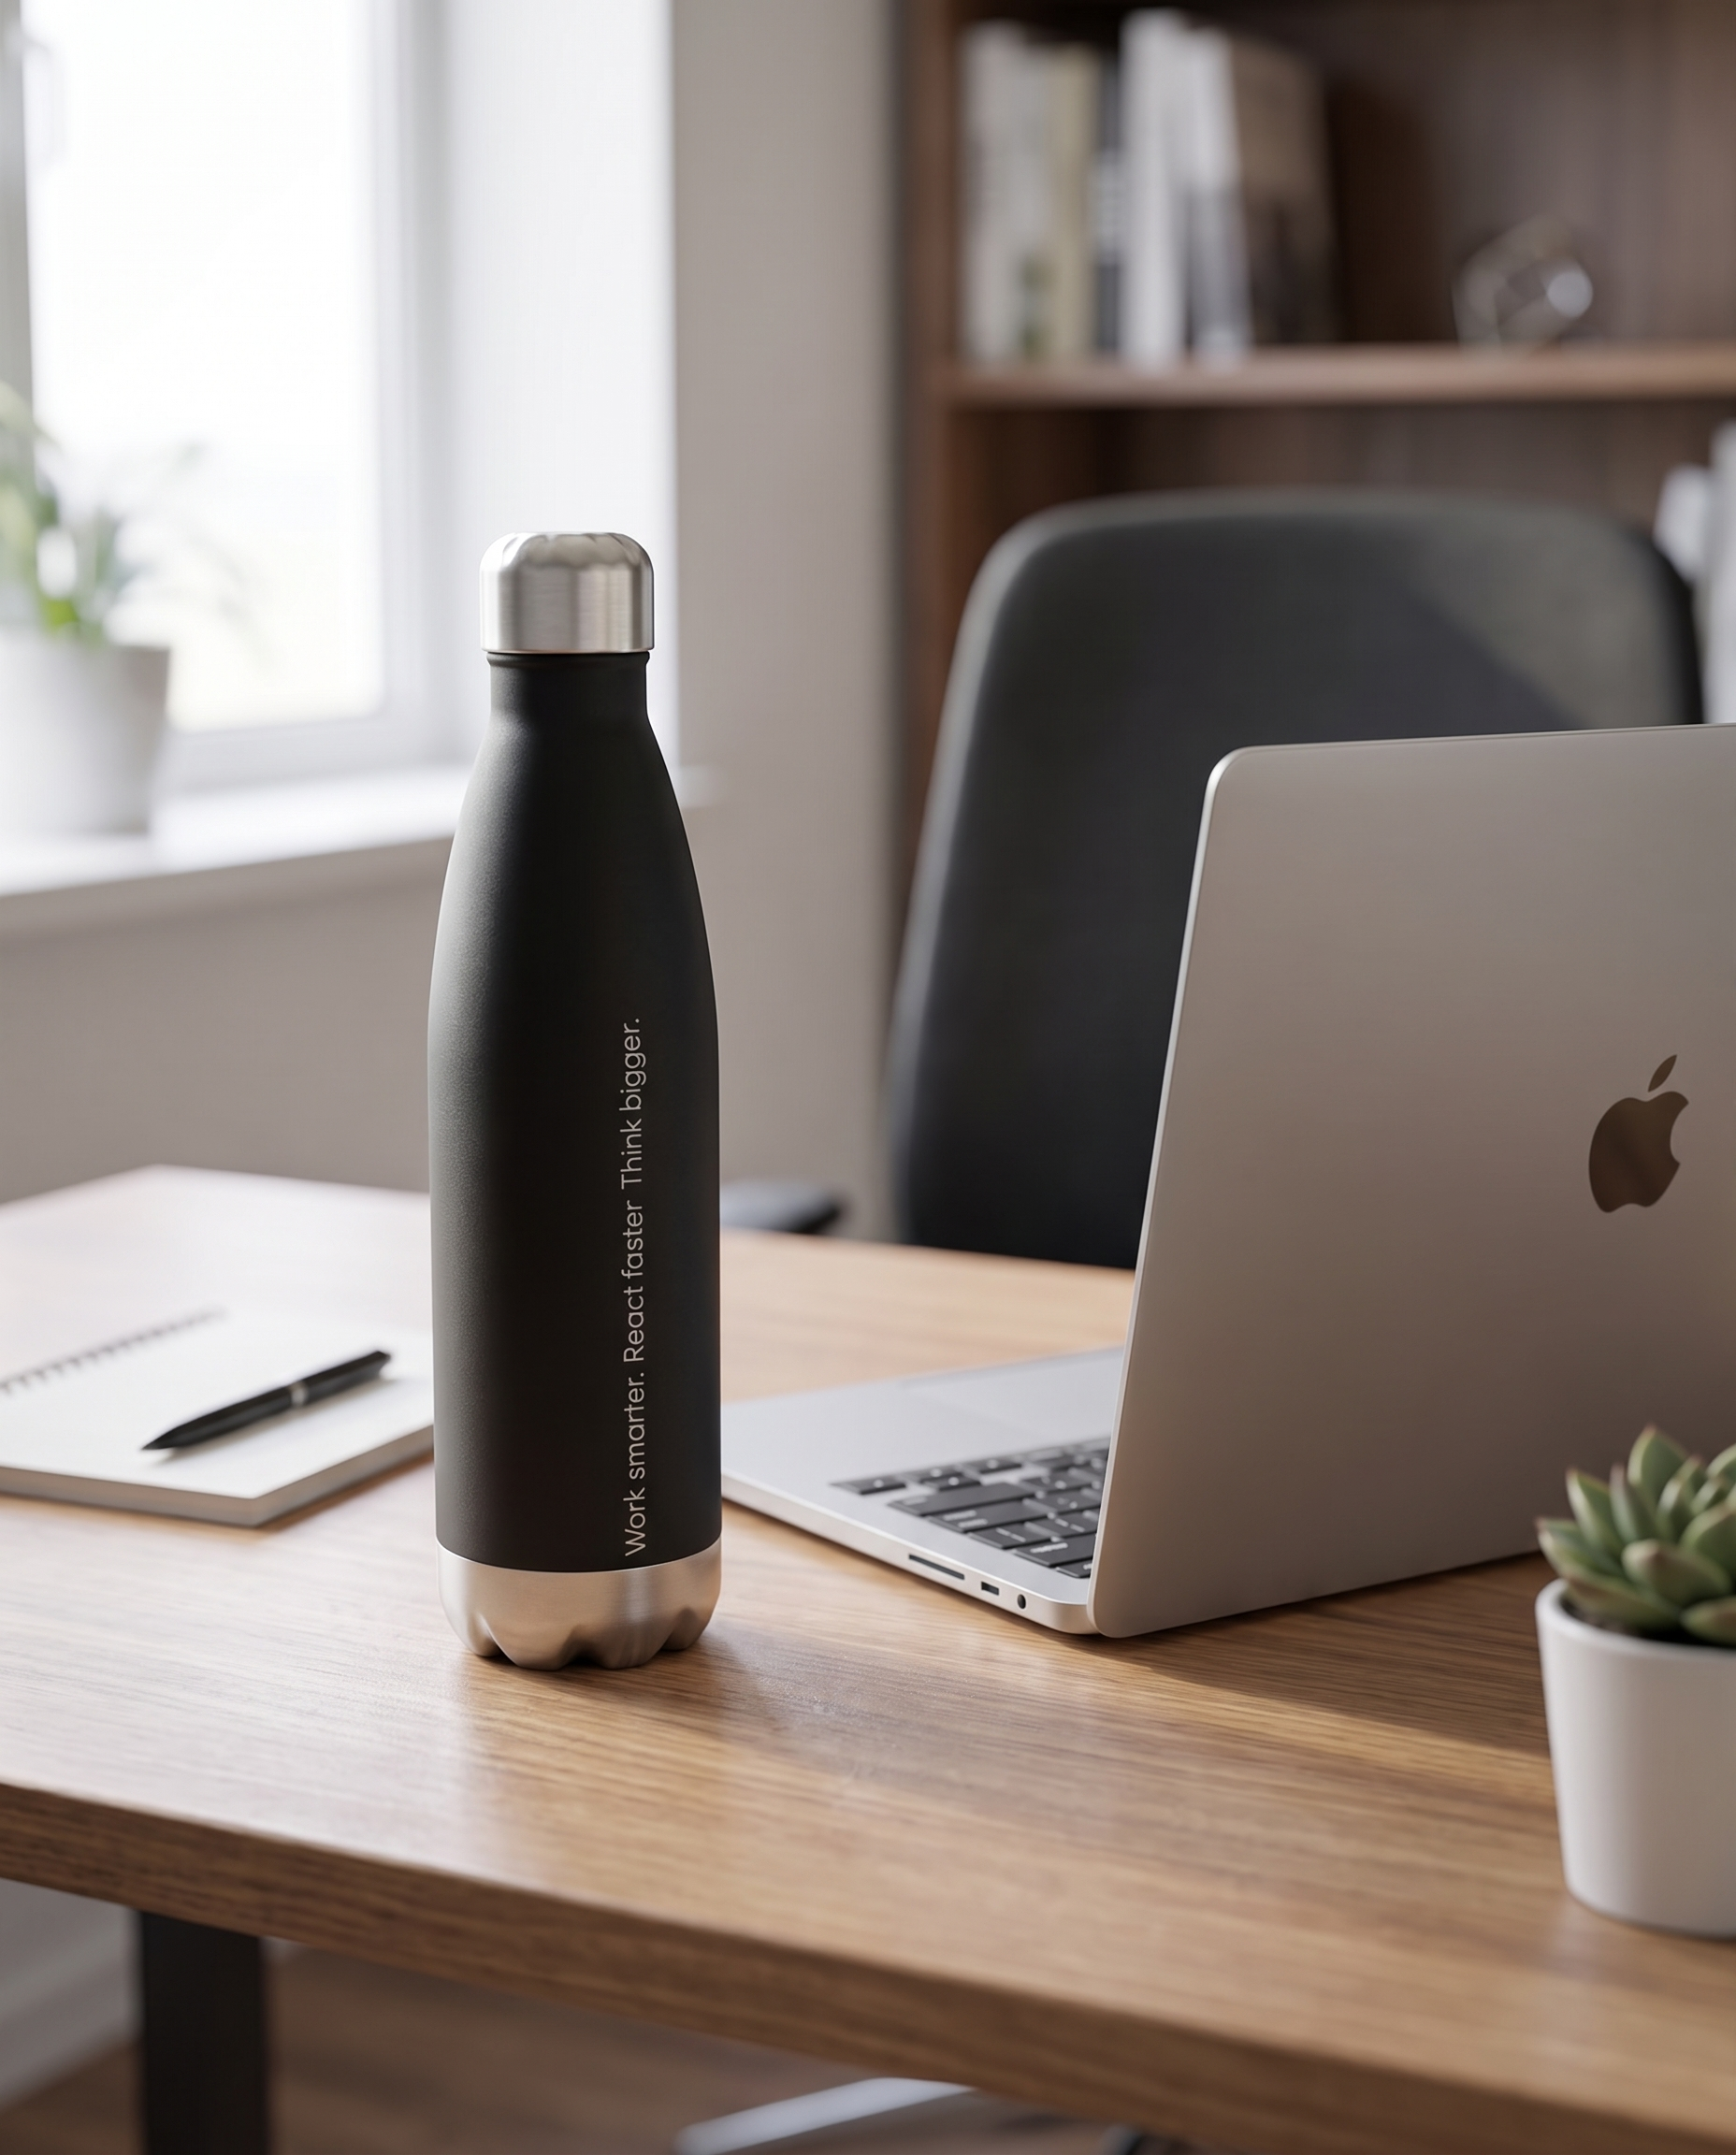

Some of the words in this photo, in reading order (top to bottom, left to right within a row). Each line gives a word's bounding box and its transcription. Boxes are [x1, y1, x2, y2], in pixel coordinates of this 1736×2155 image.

[620, 1018, 647, 1112] bigger.
[620, 1118, 644, 1191] Think
[621, 1200, 644, 1280] faster
[623, 1286, 644, 1363] React
[624, 1372, 646, 1481] smarter.
[625, 1487, 646, 1556] Work
